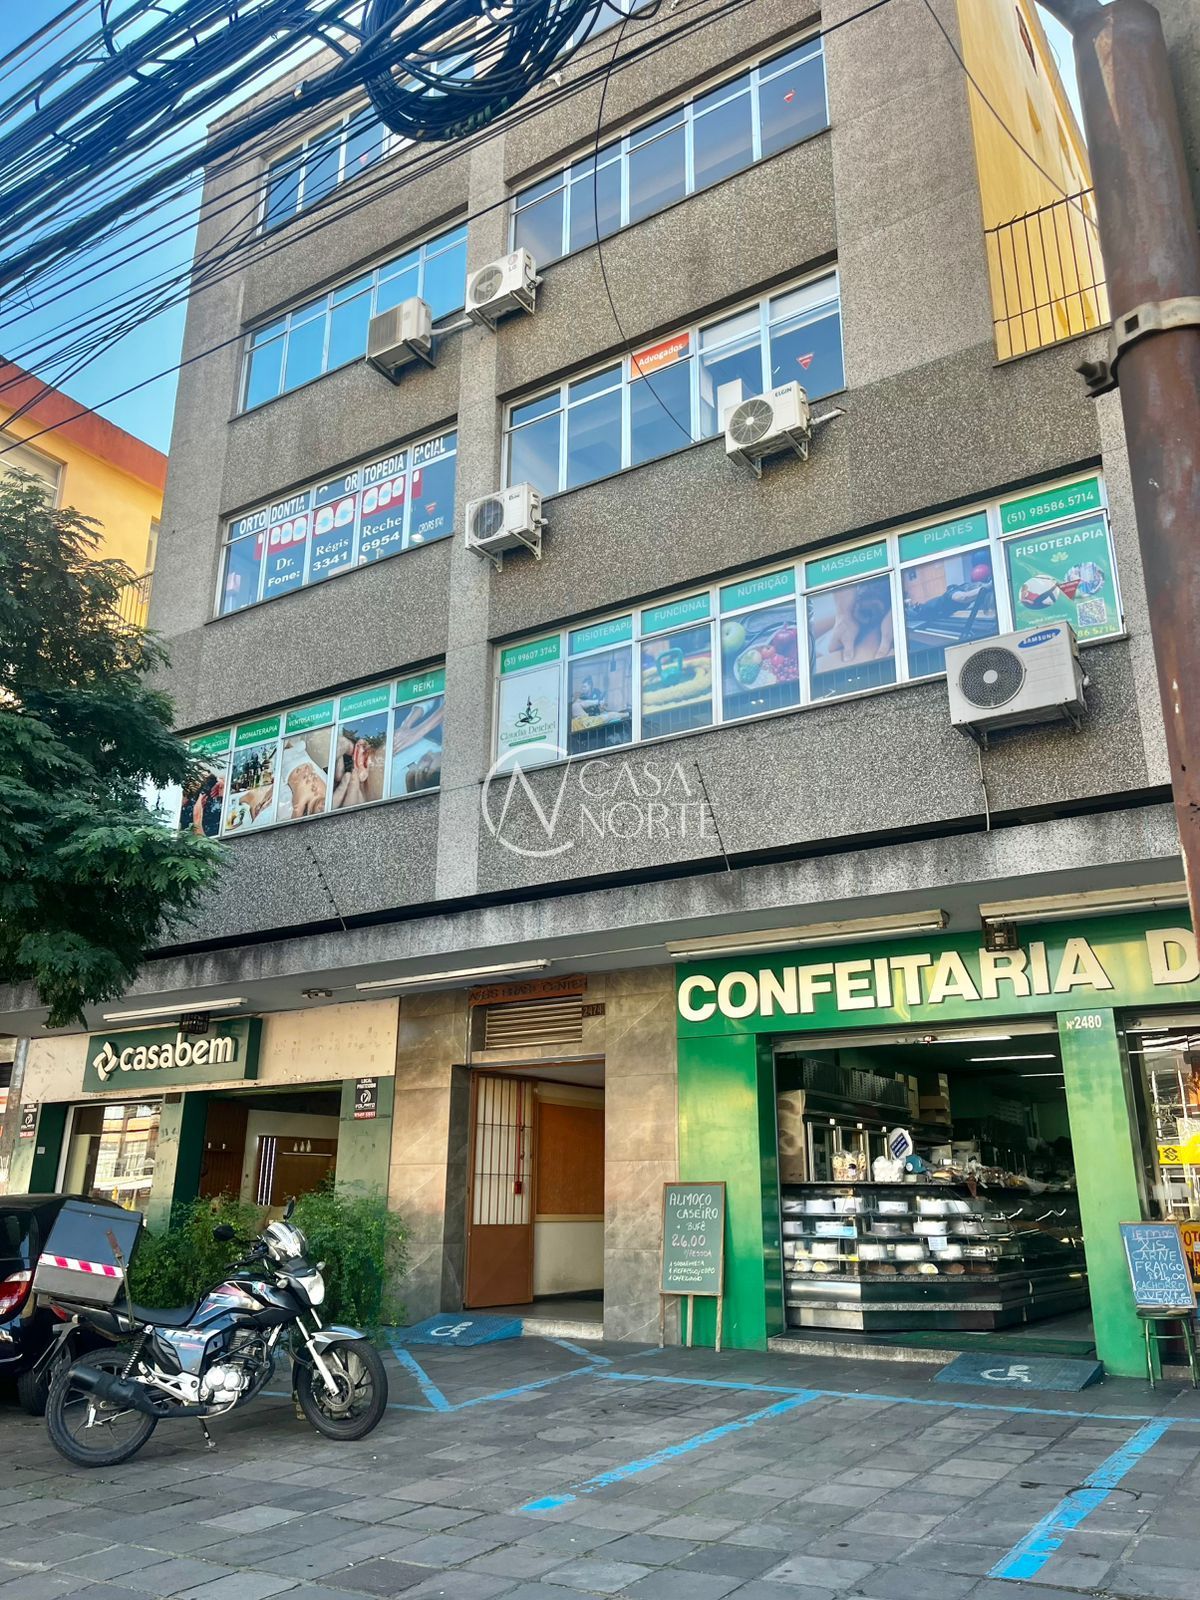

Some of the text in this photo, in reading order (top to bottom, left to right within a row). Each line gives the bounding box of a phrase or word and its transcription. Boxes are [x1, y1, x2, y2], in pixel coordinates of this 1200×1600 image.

[639, 343, 684, 366] Advogados
[775, 386, 792, 397] ELGIN
[1007, 491, 1094, 524] (51) 98586.5714
[923, 522, 973, 544] PILATES
[275, 557, 295, 571] Dr.
[316, 537, 349, 556] Régis
[362, 516, 402, 538] Reche
[1015, 529, 1104, 558] FISIOTERAPIA
[267, 530, 400, 587] Fone: 3341 6954
[821, 548, 883, 573] MASSAGEM
[737, 574, 788, 598] NUTRIÇÃO
[654, 600, 707, 621] FUNCIONAL
[1023, 632, 1057, 645] SAMSUNG
[504, 655, 516, 667] (51)
[413, 680, 435, 694] REIKI
[342, 695, 387, 712] AURICULOTERAPIA
[289, 711, 330, 727] VENTOSATERAPIA
[238, 725, 278, 741] AROMATERAPIA
[677, 937, 1114, 1022] CONFEITARIA
[119, 1032, 236, 1071] casabem
[669, 1192, 712, 1209] ALMOÇO
[676, 1207, 719, 1220] CASEIRO
[686, 1220, 706, 1232] BUFÊ
[1131, 1250, 1177, 1261] CARNE
[1136, 1280, 1186, 1290] CACHORRO
